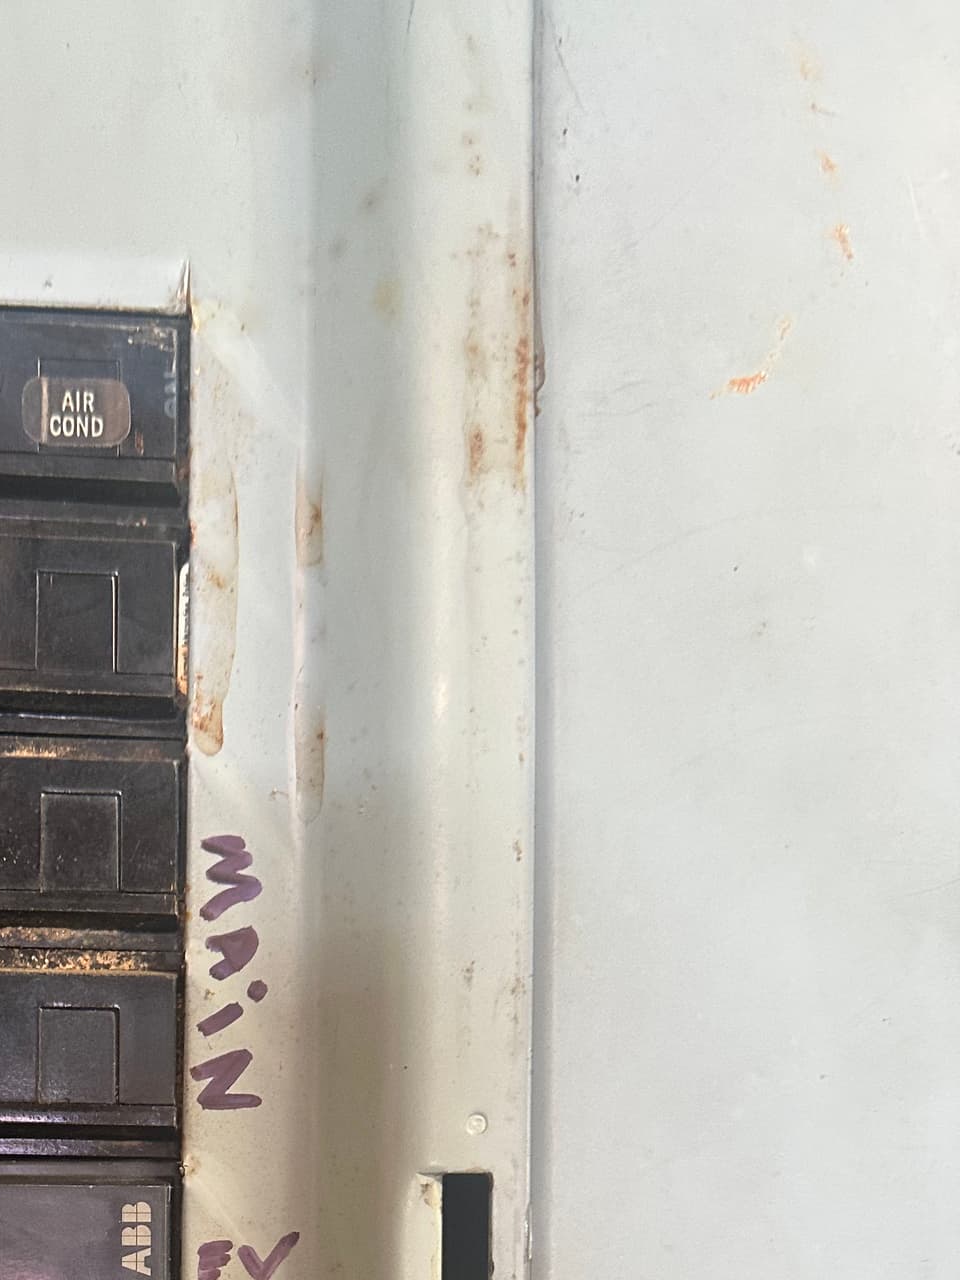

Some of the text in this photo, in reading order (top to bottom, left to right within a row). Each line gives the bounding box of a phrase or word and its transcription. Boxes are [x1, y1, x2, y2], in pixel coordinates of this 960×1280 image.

[61, 389, 95, 411] AIR
[49, 415, 104, 437] COND
[121, 1201, 153, 1276] ABB
